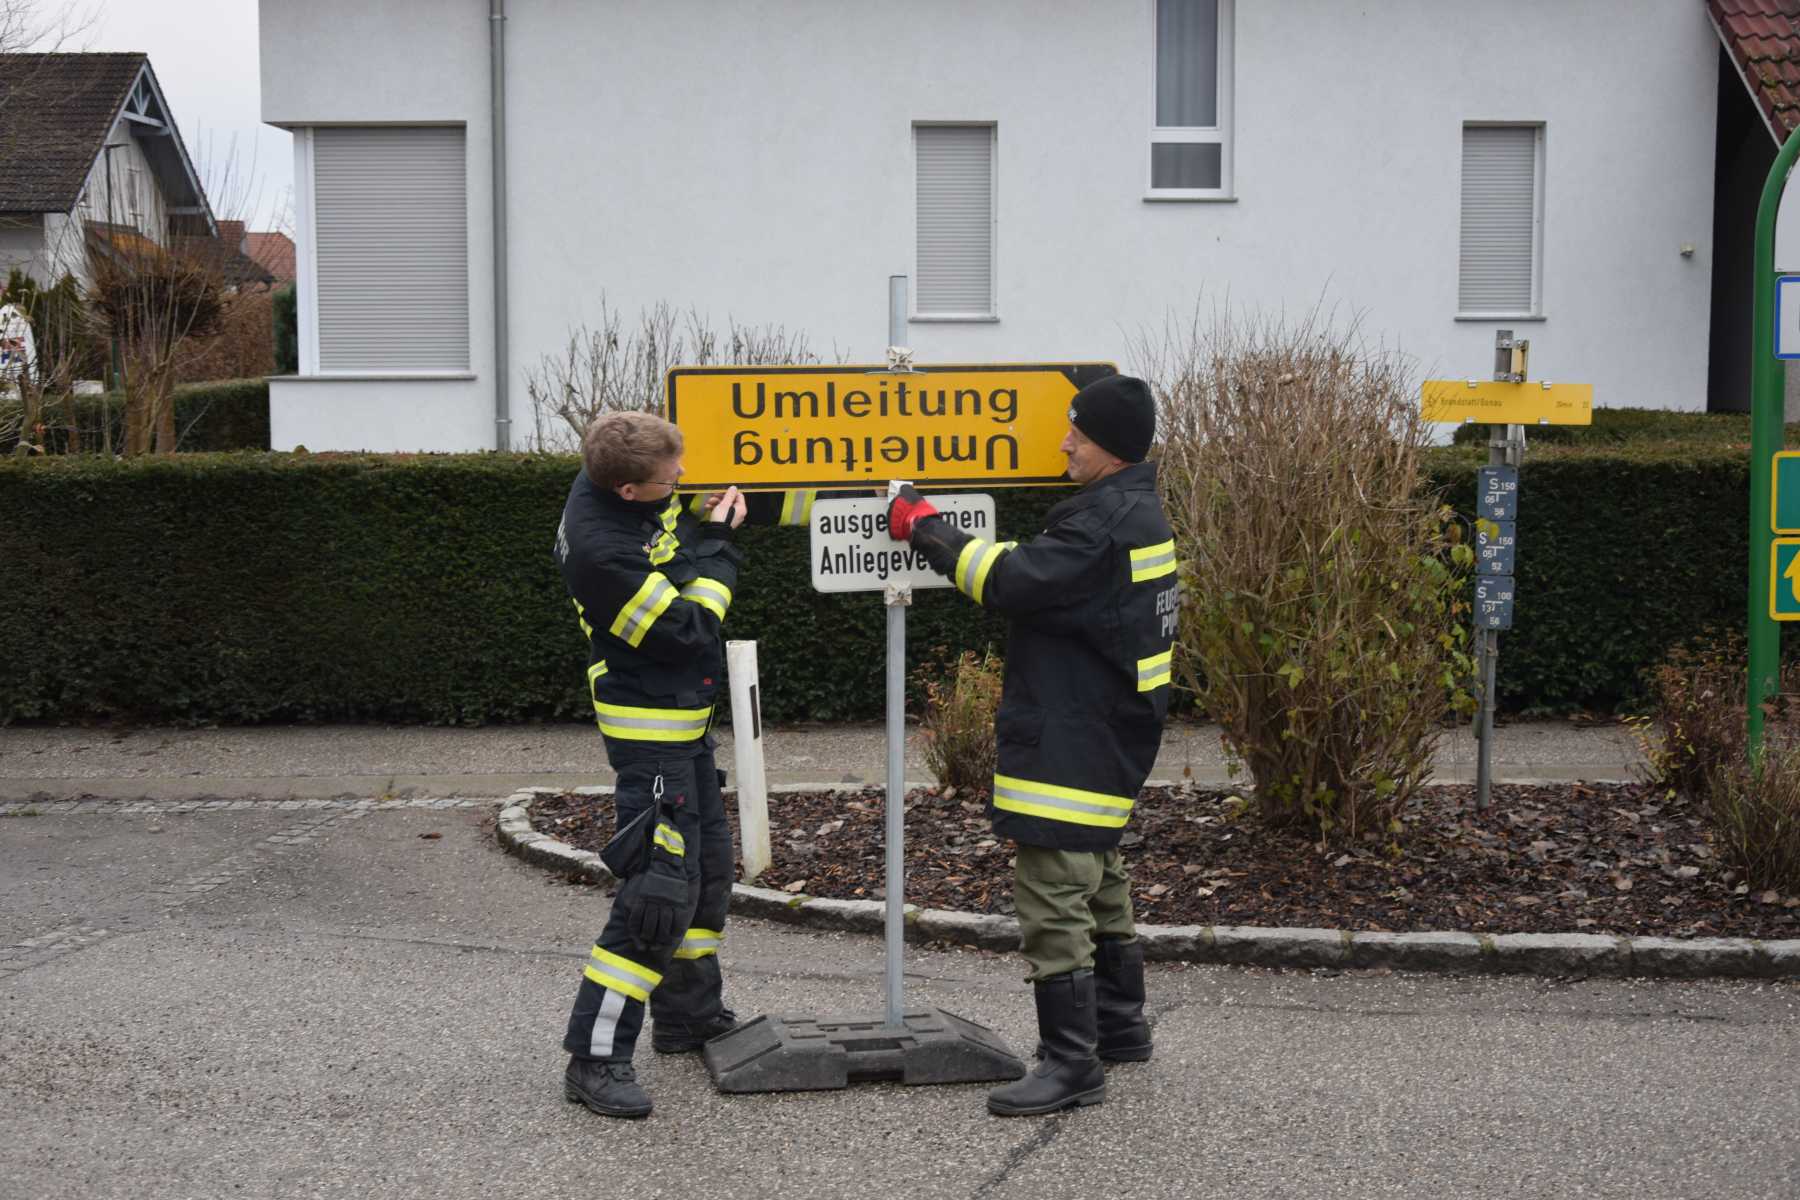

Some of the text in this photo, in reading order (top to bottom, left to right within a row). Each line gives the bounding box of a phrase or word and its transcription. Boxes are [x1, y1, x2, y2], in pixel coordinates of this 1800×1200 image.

[731, 379, 1019, 423] Umleitung
[732, 429, 1020, 473] Umleitung
[819, 509, 987, 540] ausgemen
[1479, 532, 1488, 545] S
[819, 545, 934, 581] Anliegeve
[1477, 586, 1487, 599] S
